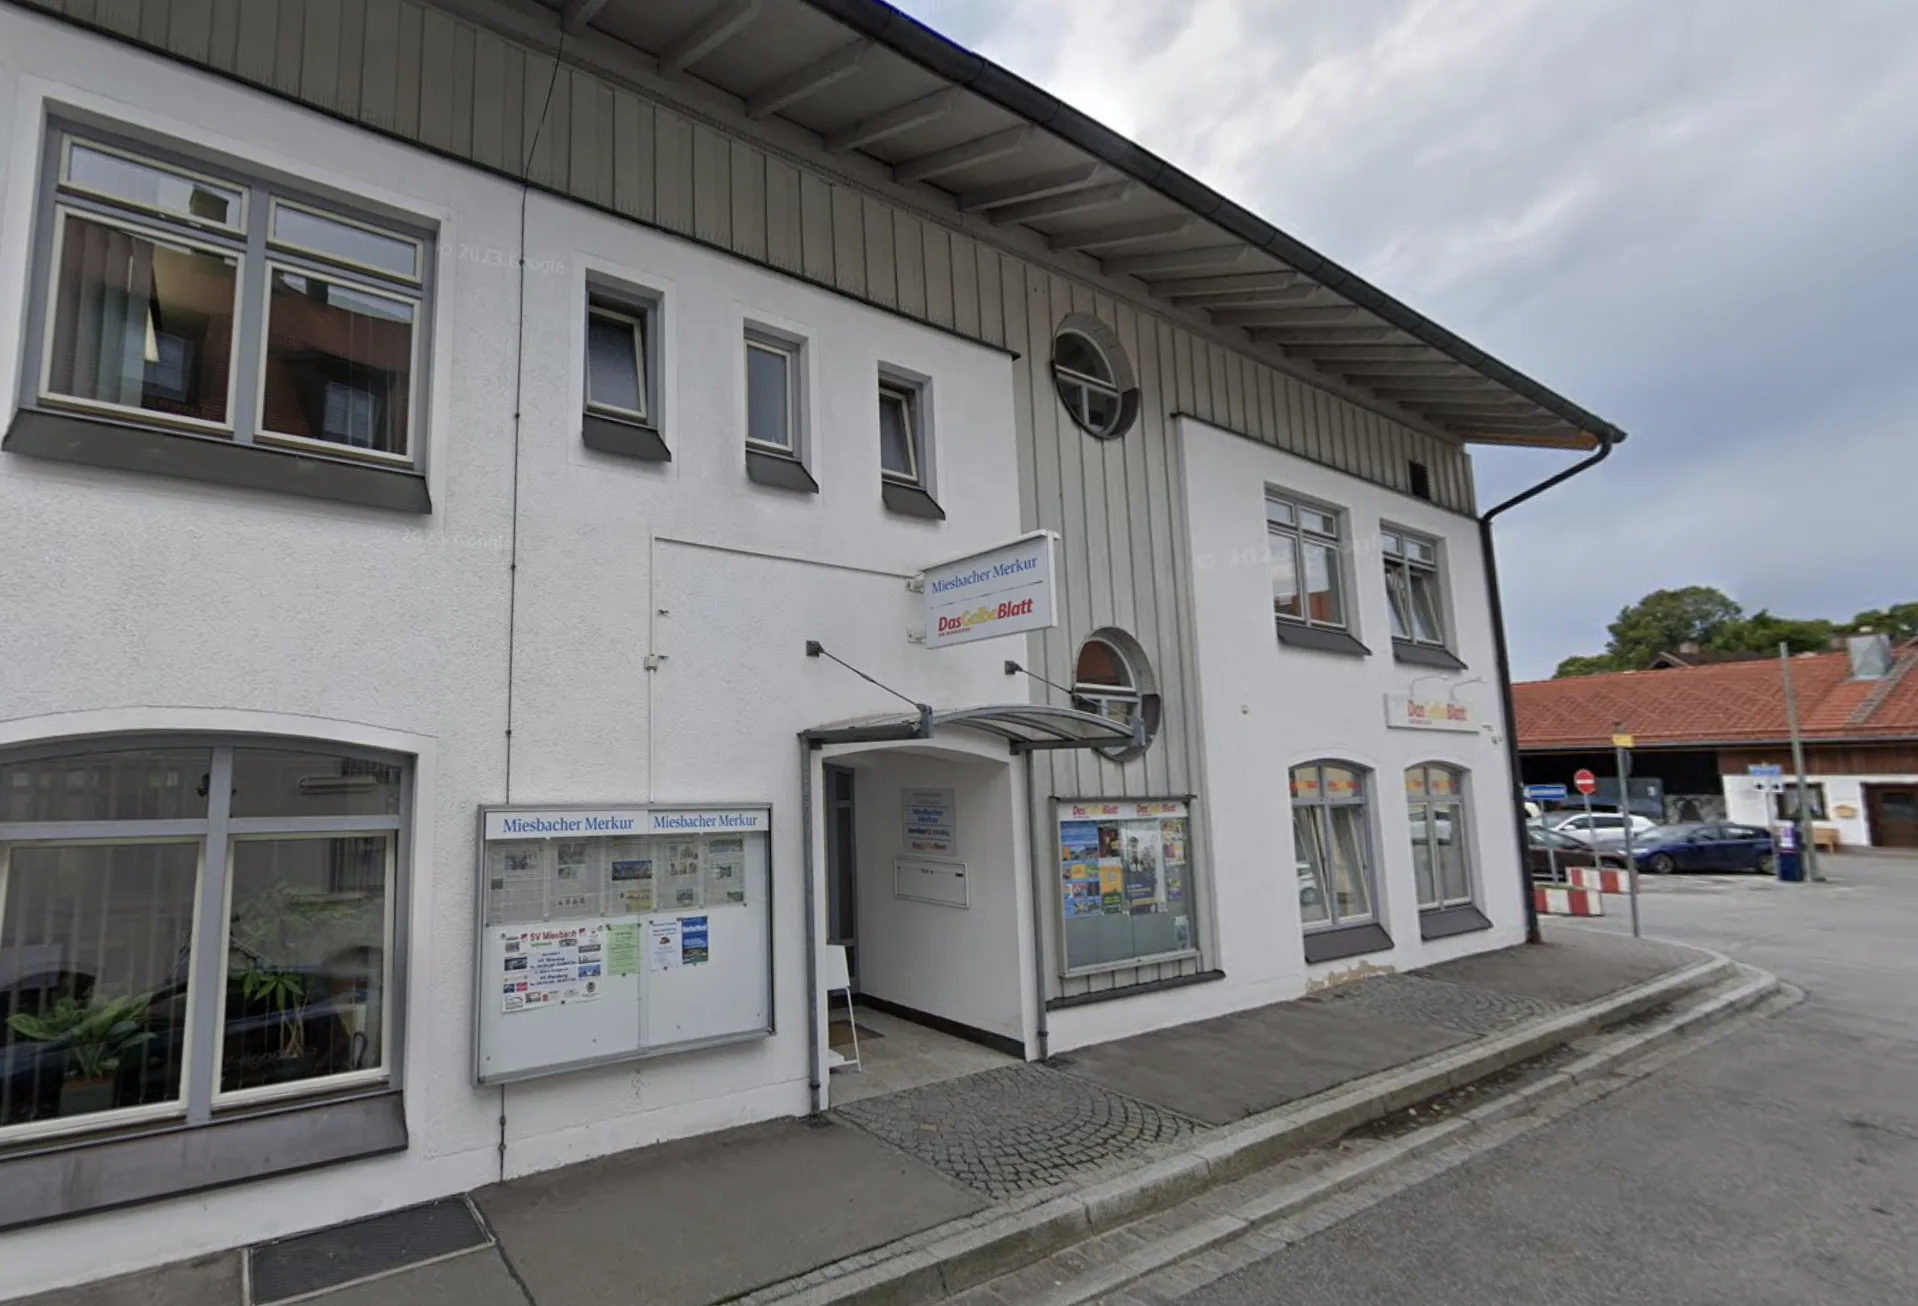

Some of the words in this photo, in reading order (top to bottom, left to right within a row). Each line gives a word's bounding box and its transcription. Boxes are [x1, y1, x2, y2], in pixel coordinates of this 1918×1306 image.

[932, 570, 991, 594] Miesbacher
[993, 557, 1038, 578] Merkur
[503, 816, 581, 832] Miesbacher
[585, 816, 634, 830] Merkur
[654, 815, 716, 828] Miesbacher
[719, 813, 758, 826] Merkur
